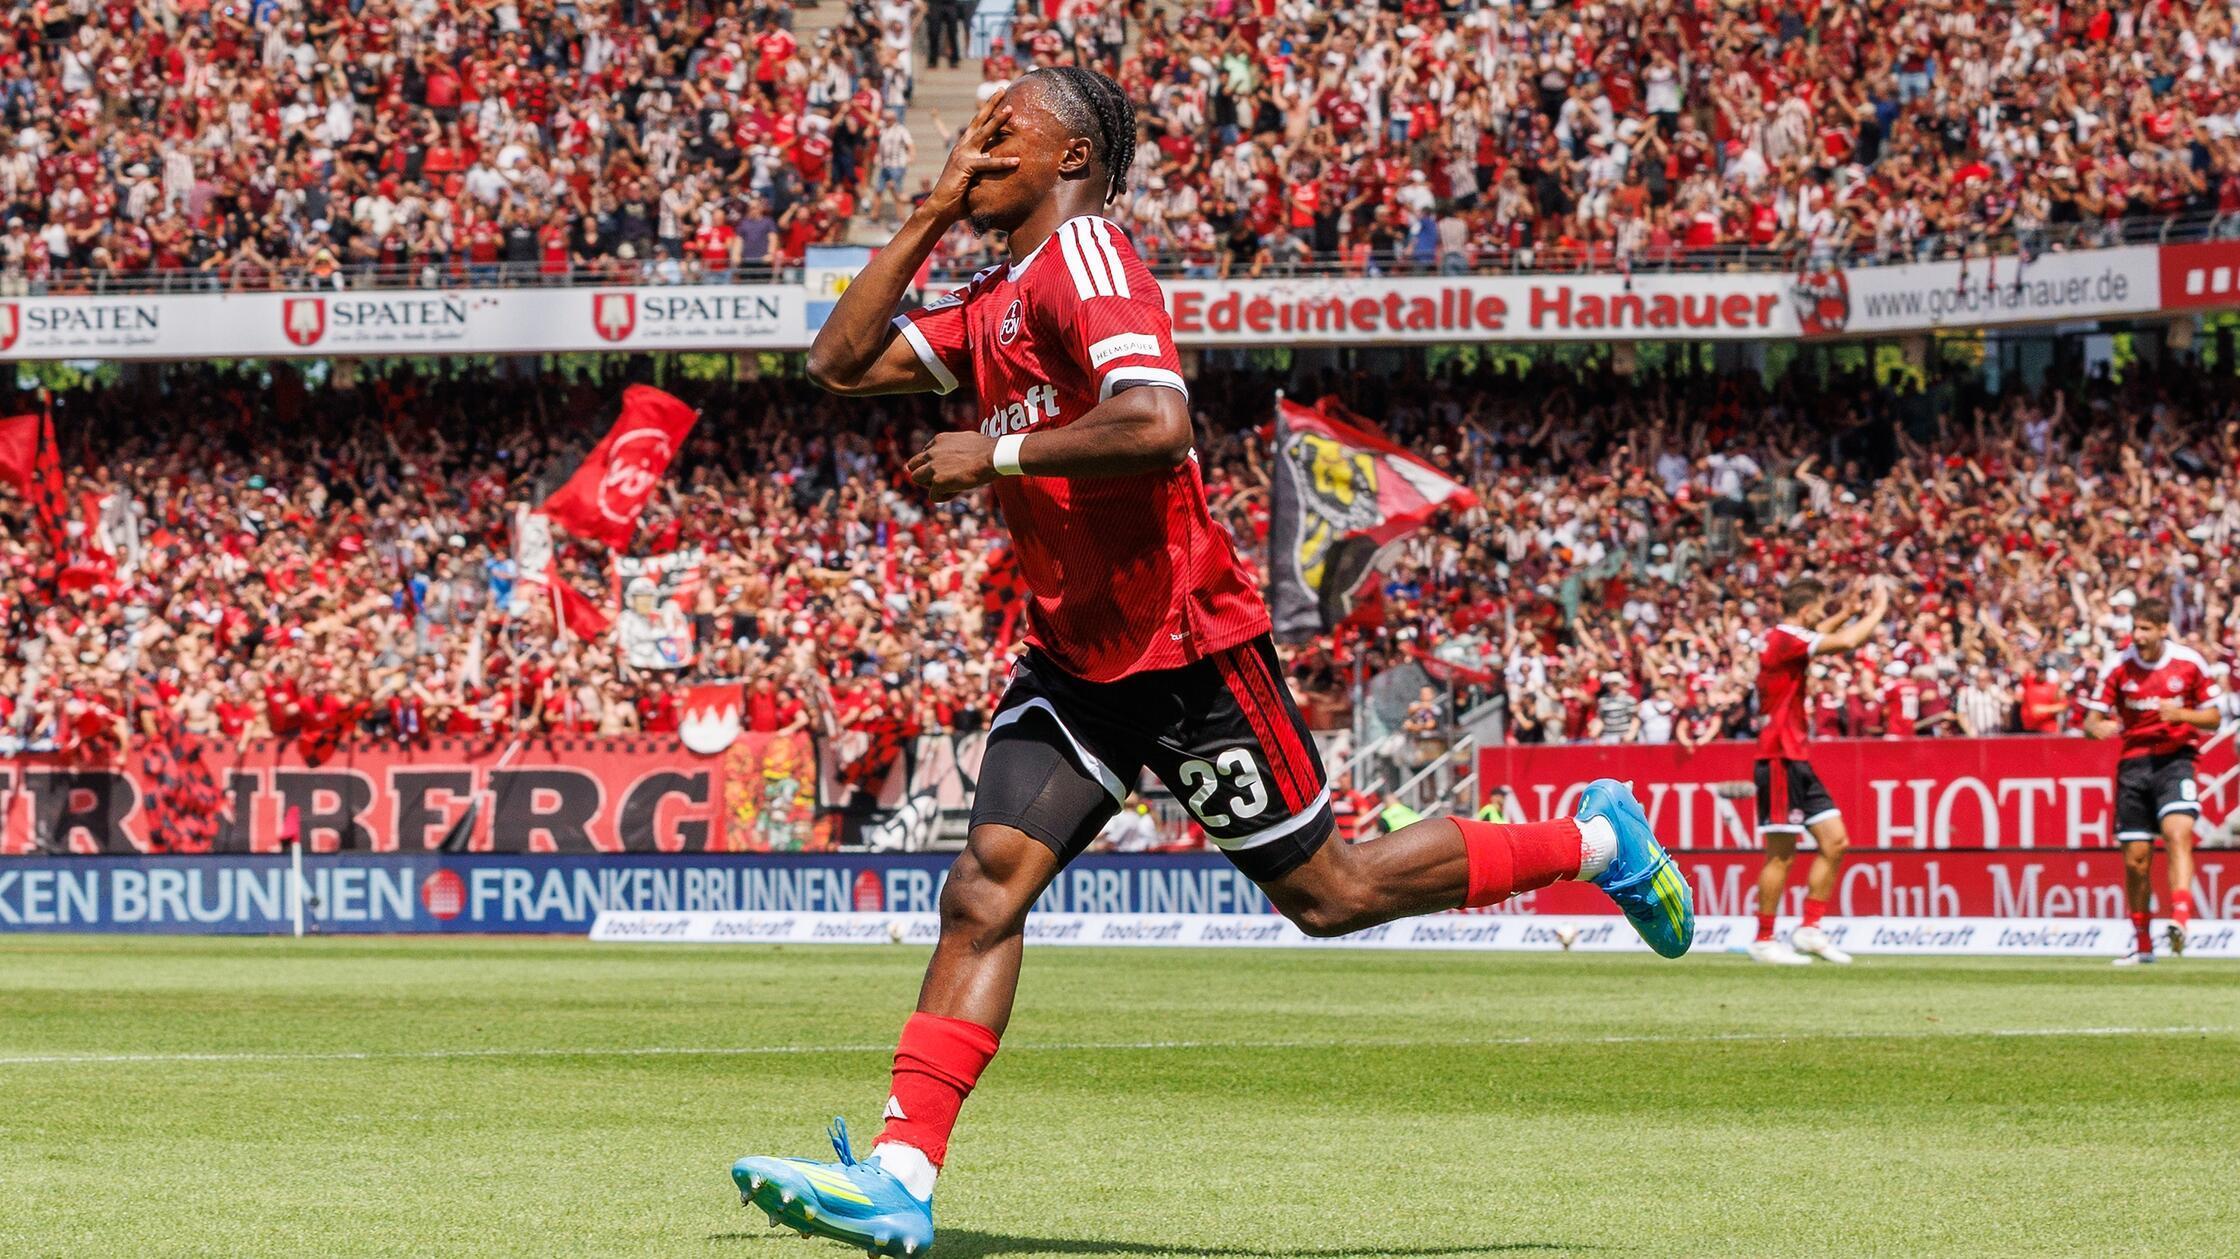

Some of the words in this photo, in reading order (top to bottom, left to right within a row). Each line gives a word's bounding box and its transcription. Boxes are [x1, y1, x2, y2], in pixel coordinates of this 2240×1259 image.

[28, 305, 159, 330] SPATEN
[333, 300, 466, 326] SPATEN
[643, 296, 780, 321] SPATEN
[1529, 286, 1781, 329] Hanauer
[1096, 342, 1153, 361] HELMSAUER
[981, 384, 1061, 438] craft
[1179, 747, 1268, 828] 23
[0, 766, 714, 852] RBERG
[112, 867, 415, 922] BRUNNEN
[471, 867, 679, 922] FRANKEN
[683, 867, 851, 912] BRUNNEN
[1840, 860, 1961, 918] Club
[604, 916, 693, 936] toolcraft
[711, 917, 797, 937] toolcraft
[1101, 919, 1184, 940] toolcraft
[1200, 920, 1284, 940] toolcraft
[1410, 922, 1501, 942] toolcraft
[1521, 923, 1616, 944] tooraft
[1872, 927, 1974, 947] toolcraft
[1998, 927, 2102, 949] toolcraft
